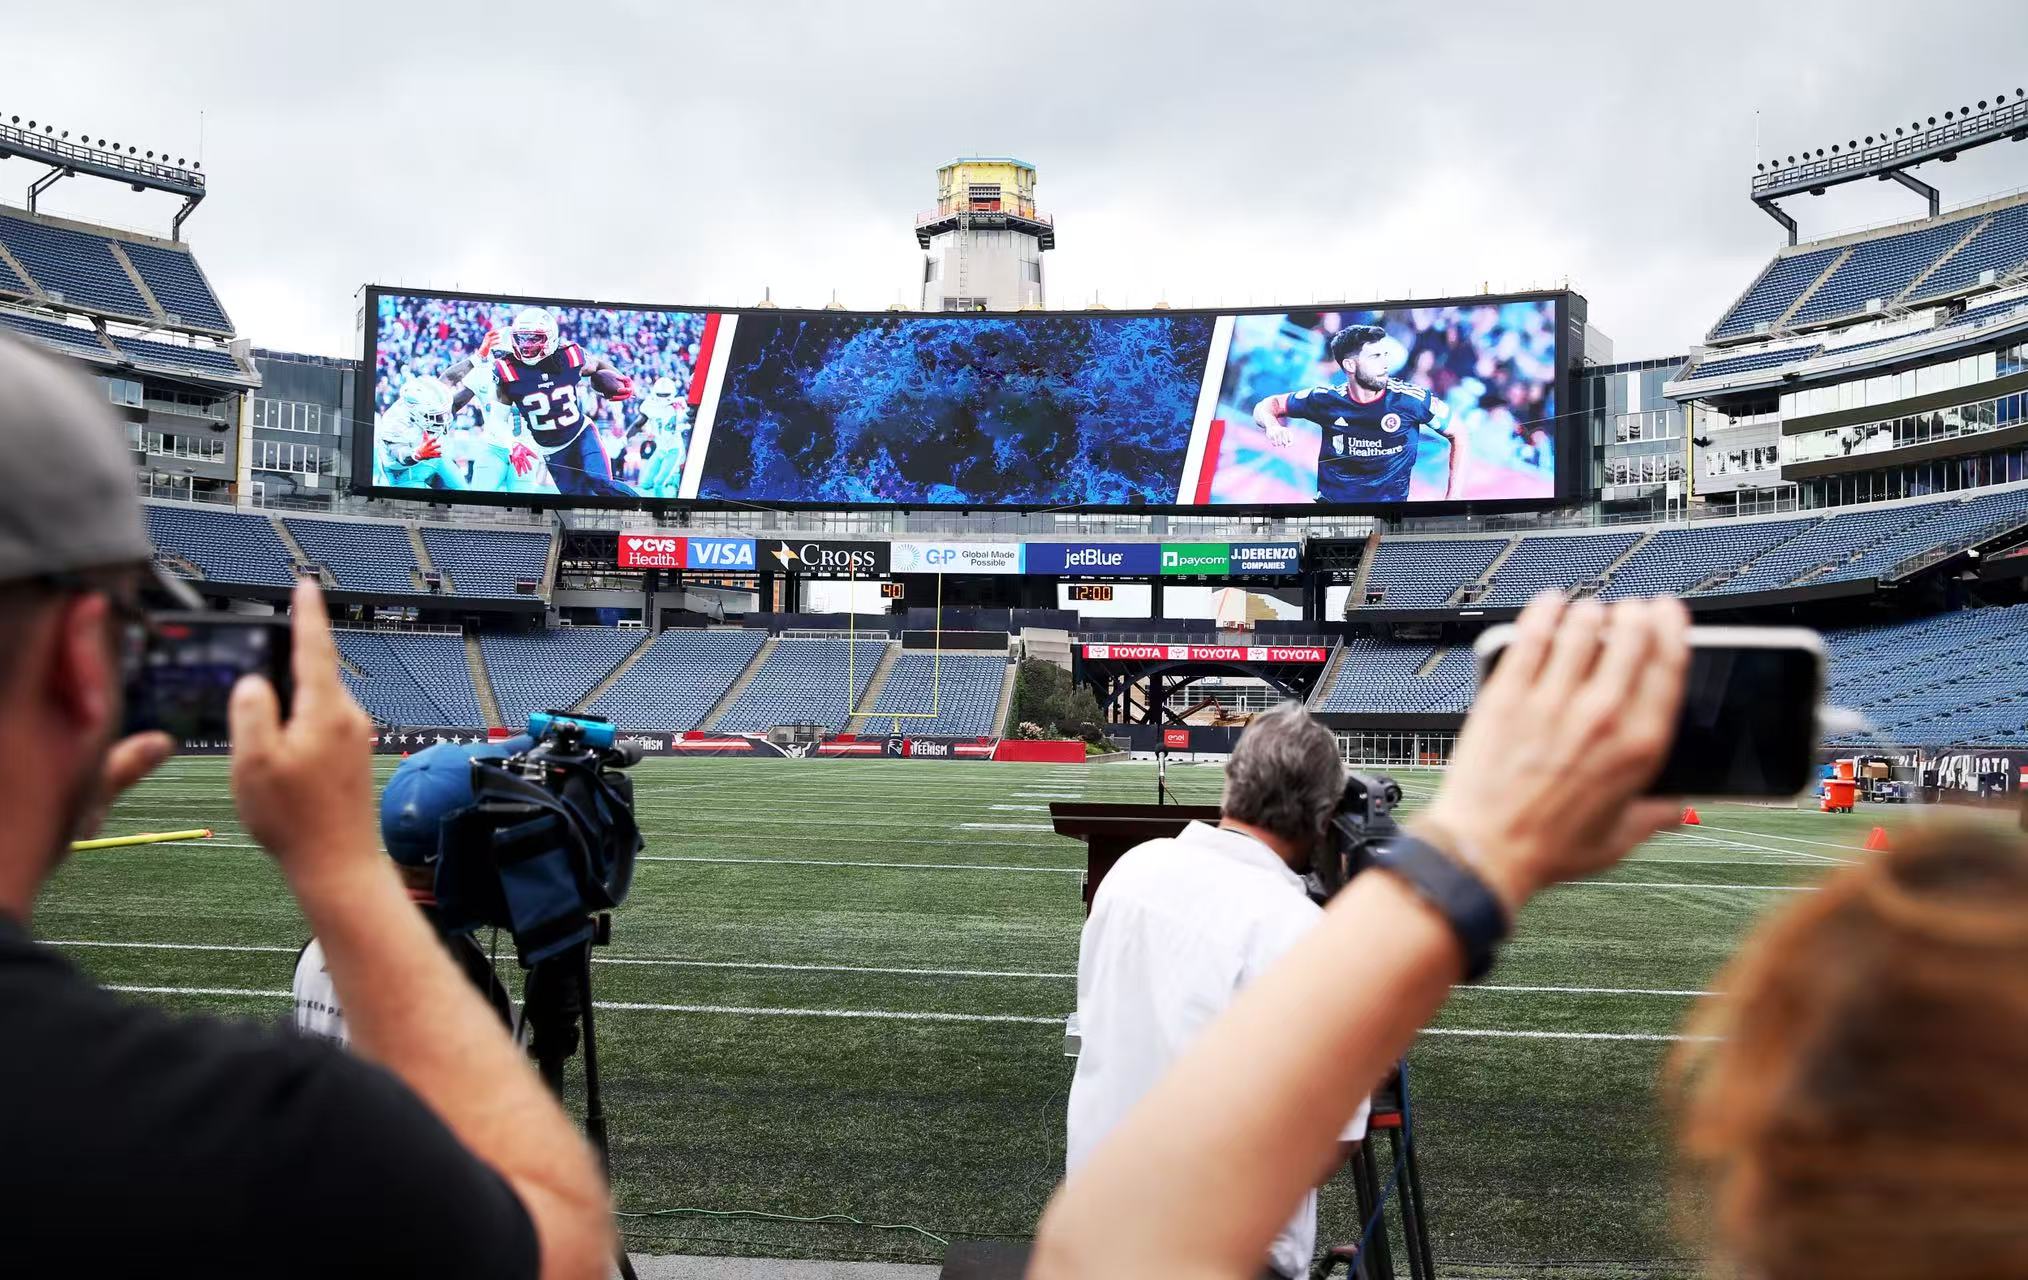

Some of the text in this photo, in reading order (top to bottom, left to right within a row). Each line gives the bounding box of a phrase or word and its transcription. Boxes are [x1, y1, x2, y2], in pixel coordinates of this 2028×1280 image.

[522, 384, 580, 431] 23
[1348, 437, 1382, 448] United
[1348, 445, 1403, 457] Healthcare
[643, 539, 676, 552] CVS
[690, 543, 753, 565] VISA
[800, 543, 875, 566] CROSS
[961, 550, 1015, 559] Global Made
[1064, 549, 1122, 569] jetBlue
[970, 558, 1006, 567] Possible
[1179, 557, 1225, 567] paycom
[1241, 561, 1286, 570] COMPANIES
[883, 584, 900, 597] 40
[1075, 586, 1111, 600] 12:00
[1113, 647, 1161, 658] TOYOTA
[1192, 648, 1241, 659] TOYOTA
[1271, 649, 1320, 660] TOYOTA
